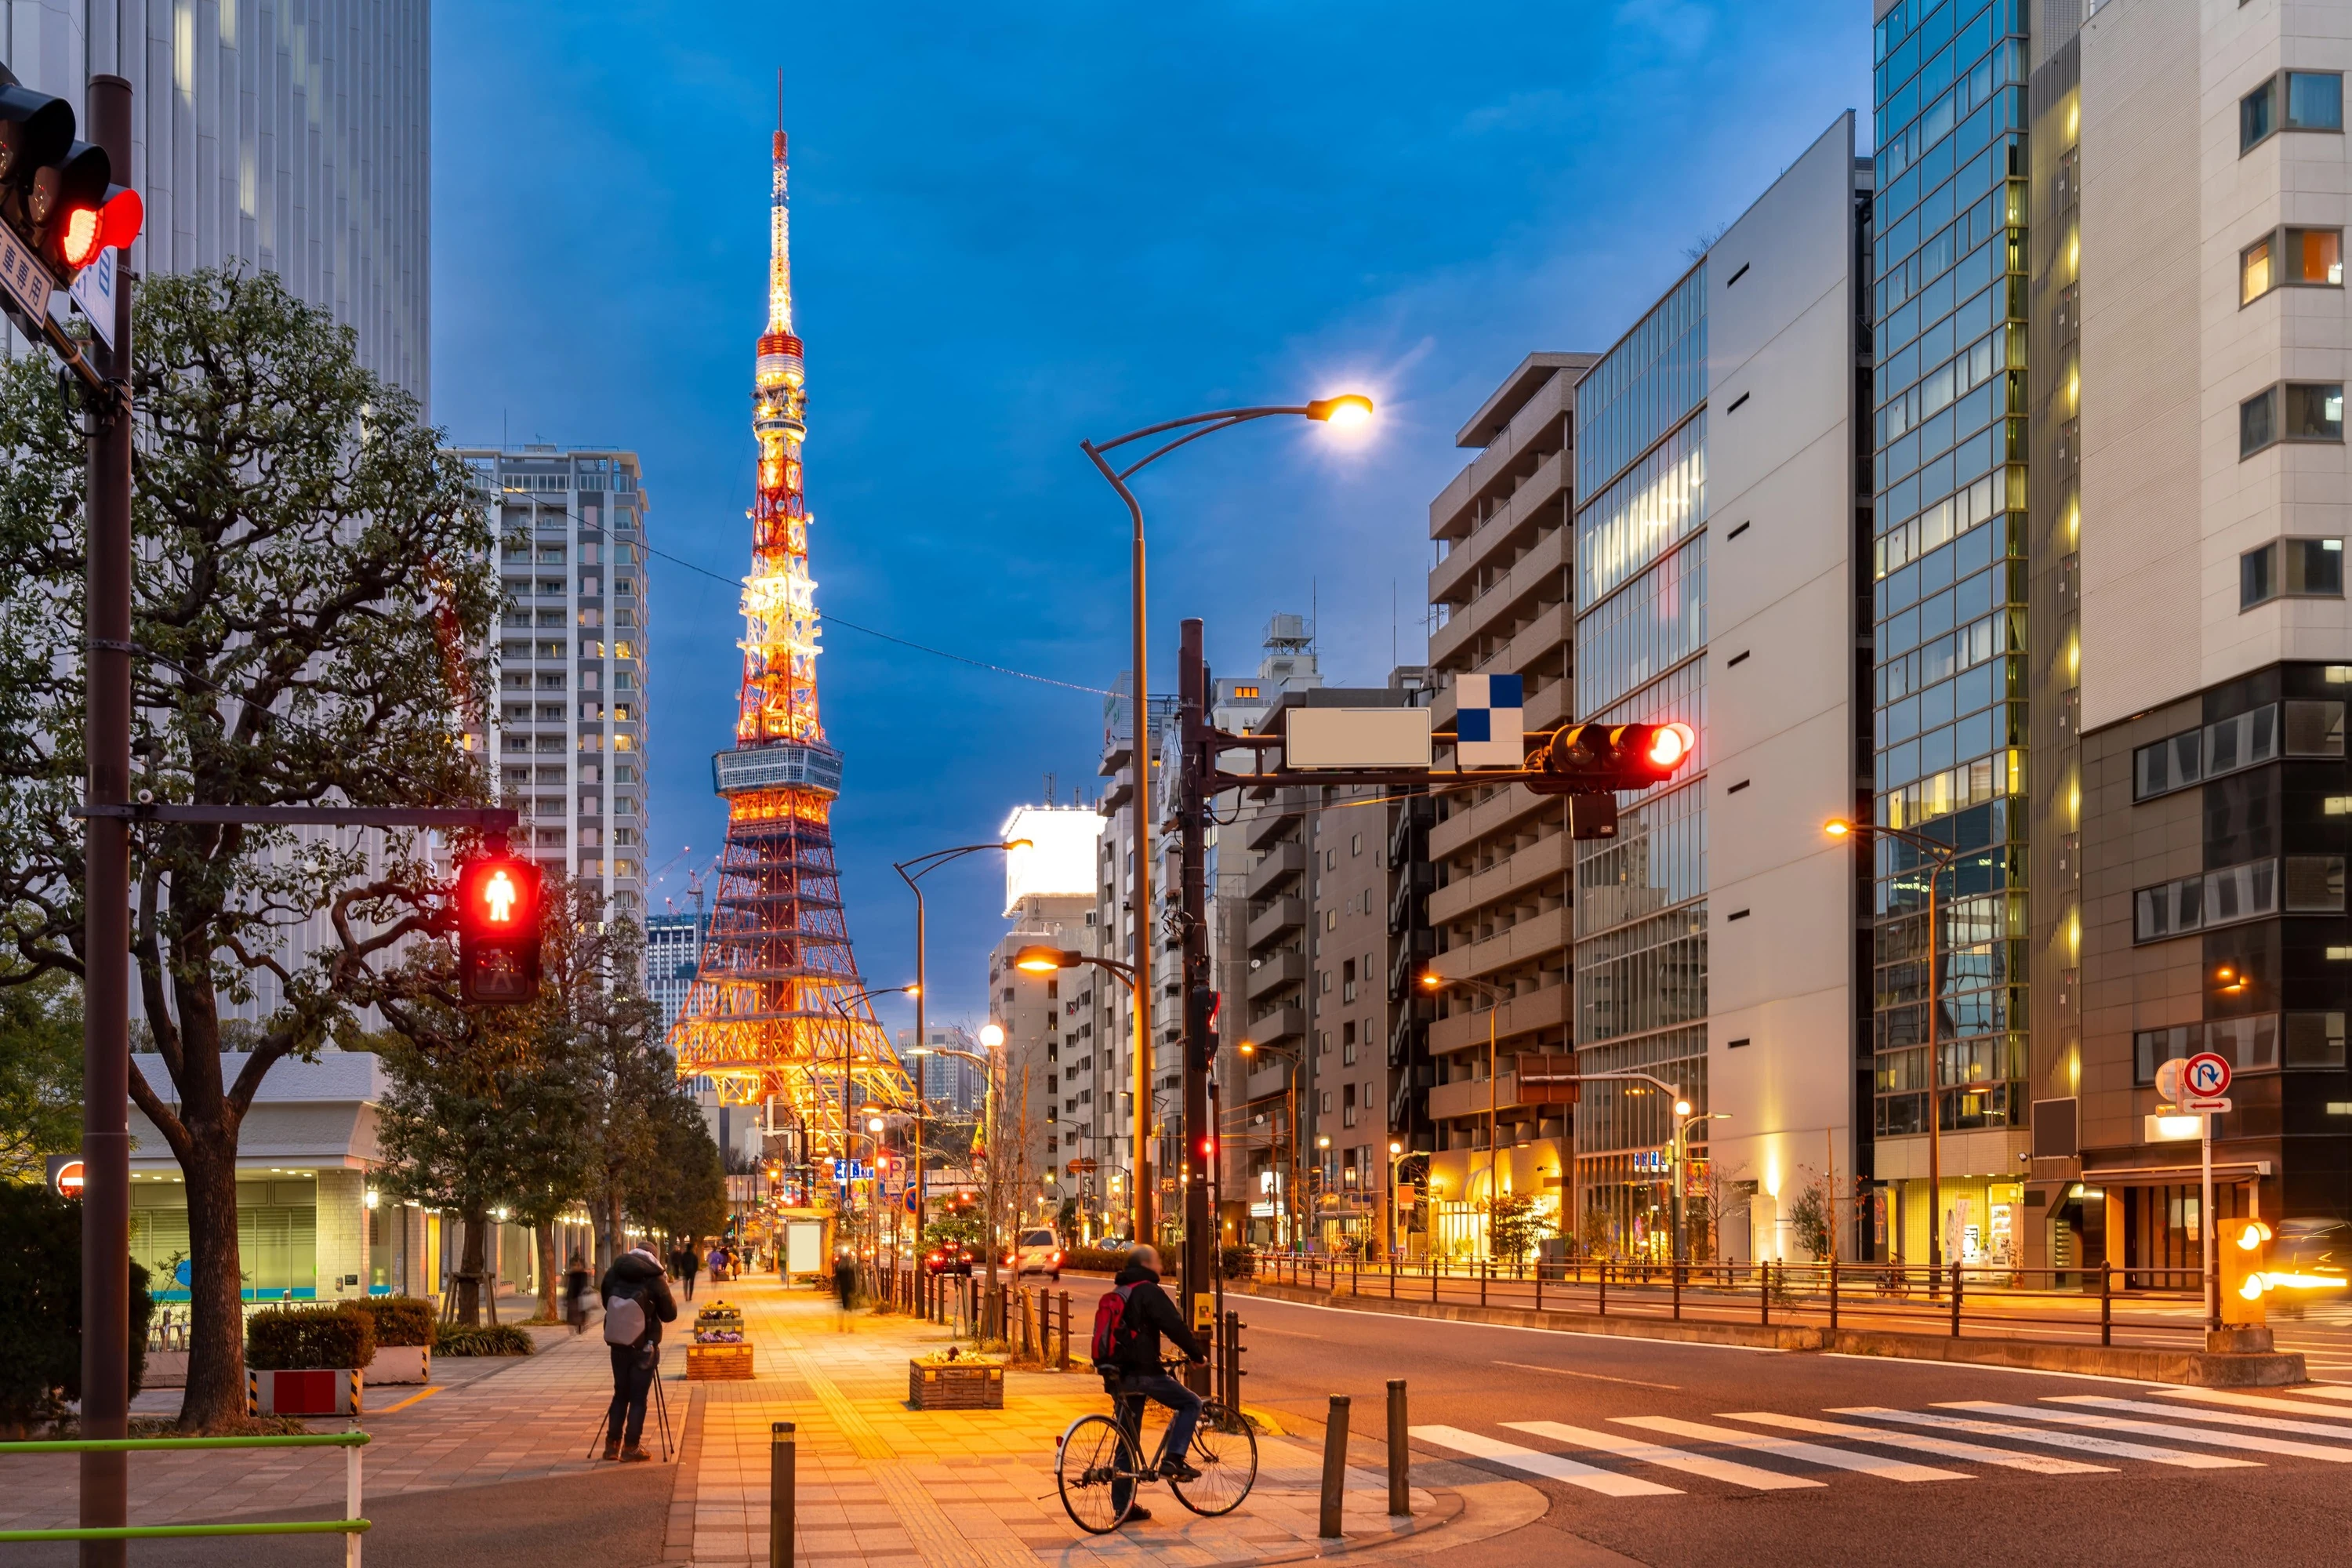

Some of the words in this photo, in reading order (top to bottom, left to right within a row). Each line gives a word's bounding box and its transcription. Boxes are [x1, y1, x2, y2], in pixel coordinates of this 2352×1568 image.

[0, 234, 42, 307] 車専用
[890, 1160, 902, 1178] P
